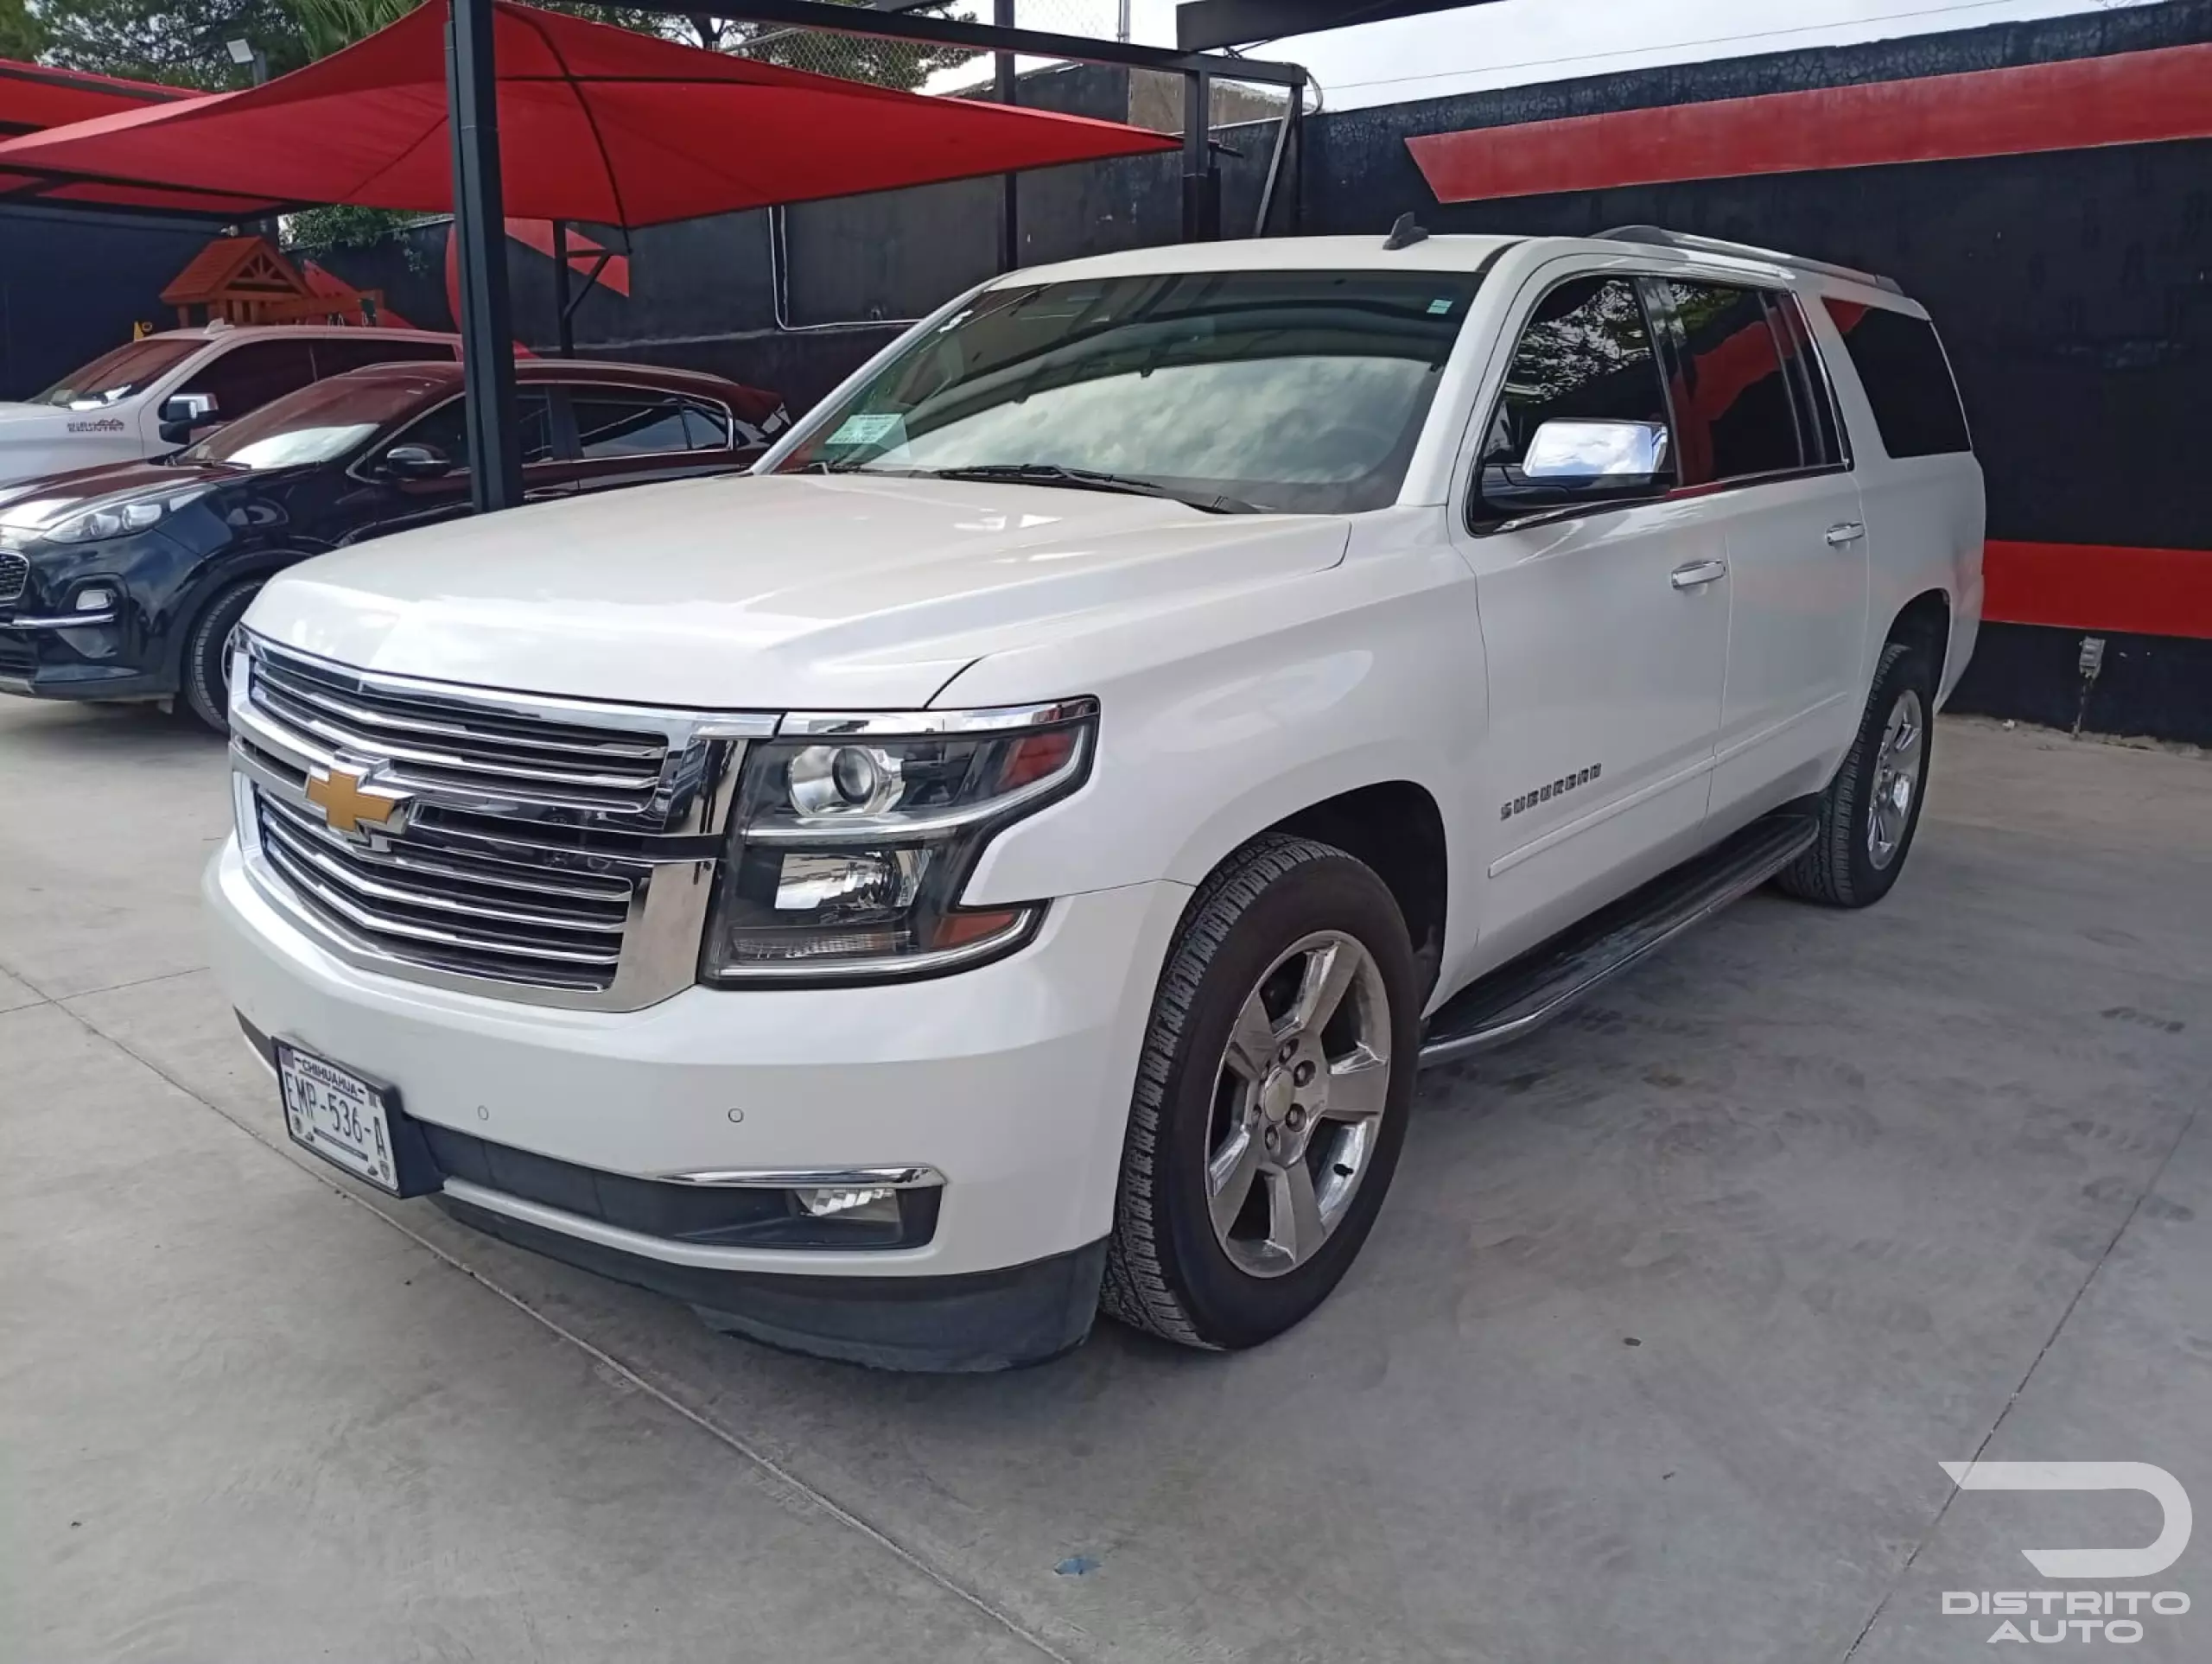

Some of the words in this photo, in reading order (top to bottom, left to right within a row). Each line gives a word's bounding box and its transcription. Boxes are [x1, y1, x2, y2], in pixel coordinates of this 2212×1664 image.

[1500, 763, 1602, 821] SUBURBAN
[302, 1058, 358, 1095] CHIHUAHUA
[284, 1071, 388, 1160] EMP-536-A
